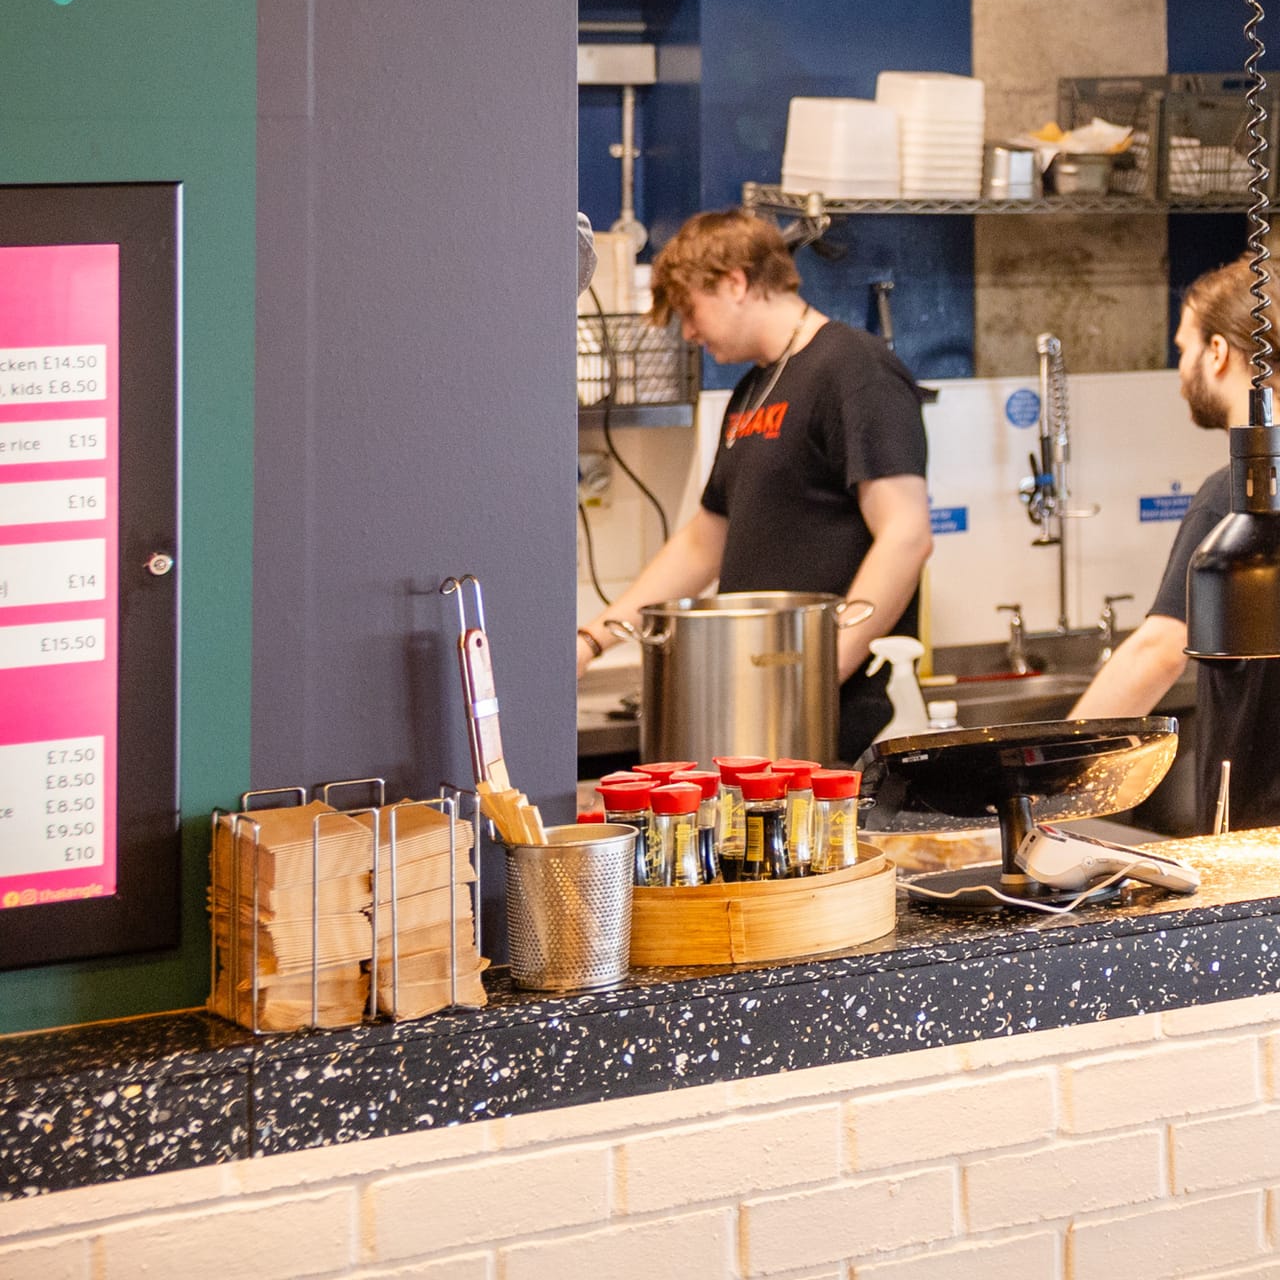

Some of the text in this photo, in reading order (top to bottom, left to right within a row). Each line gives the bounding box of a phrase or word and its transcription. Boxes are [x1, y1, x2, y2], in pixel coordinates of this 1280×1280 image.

[43, 355, 97, 370] £14.50
[11, 380, 97, 395] kids £8.50
[10, 439, 40, 451] rice
[69, 434, 97, 448] £15
[68, 494, 97, 509] £16
[68, 574, 96, 589] £14
[40, 635, 96, 652] £15.50
[47, 748, 95, 765] £7.50
[46, 773, 95, 789] £8.50
[45, 797, 95, 815] £8.50
[46, 822, 95, 839] £9.50
[64, 846, 95, 862] £10
